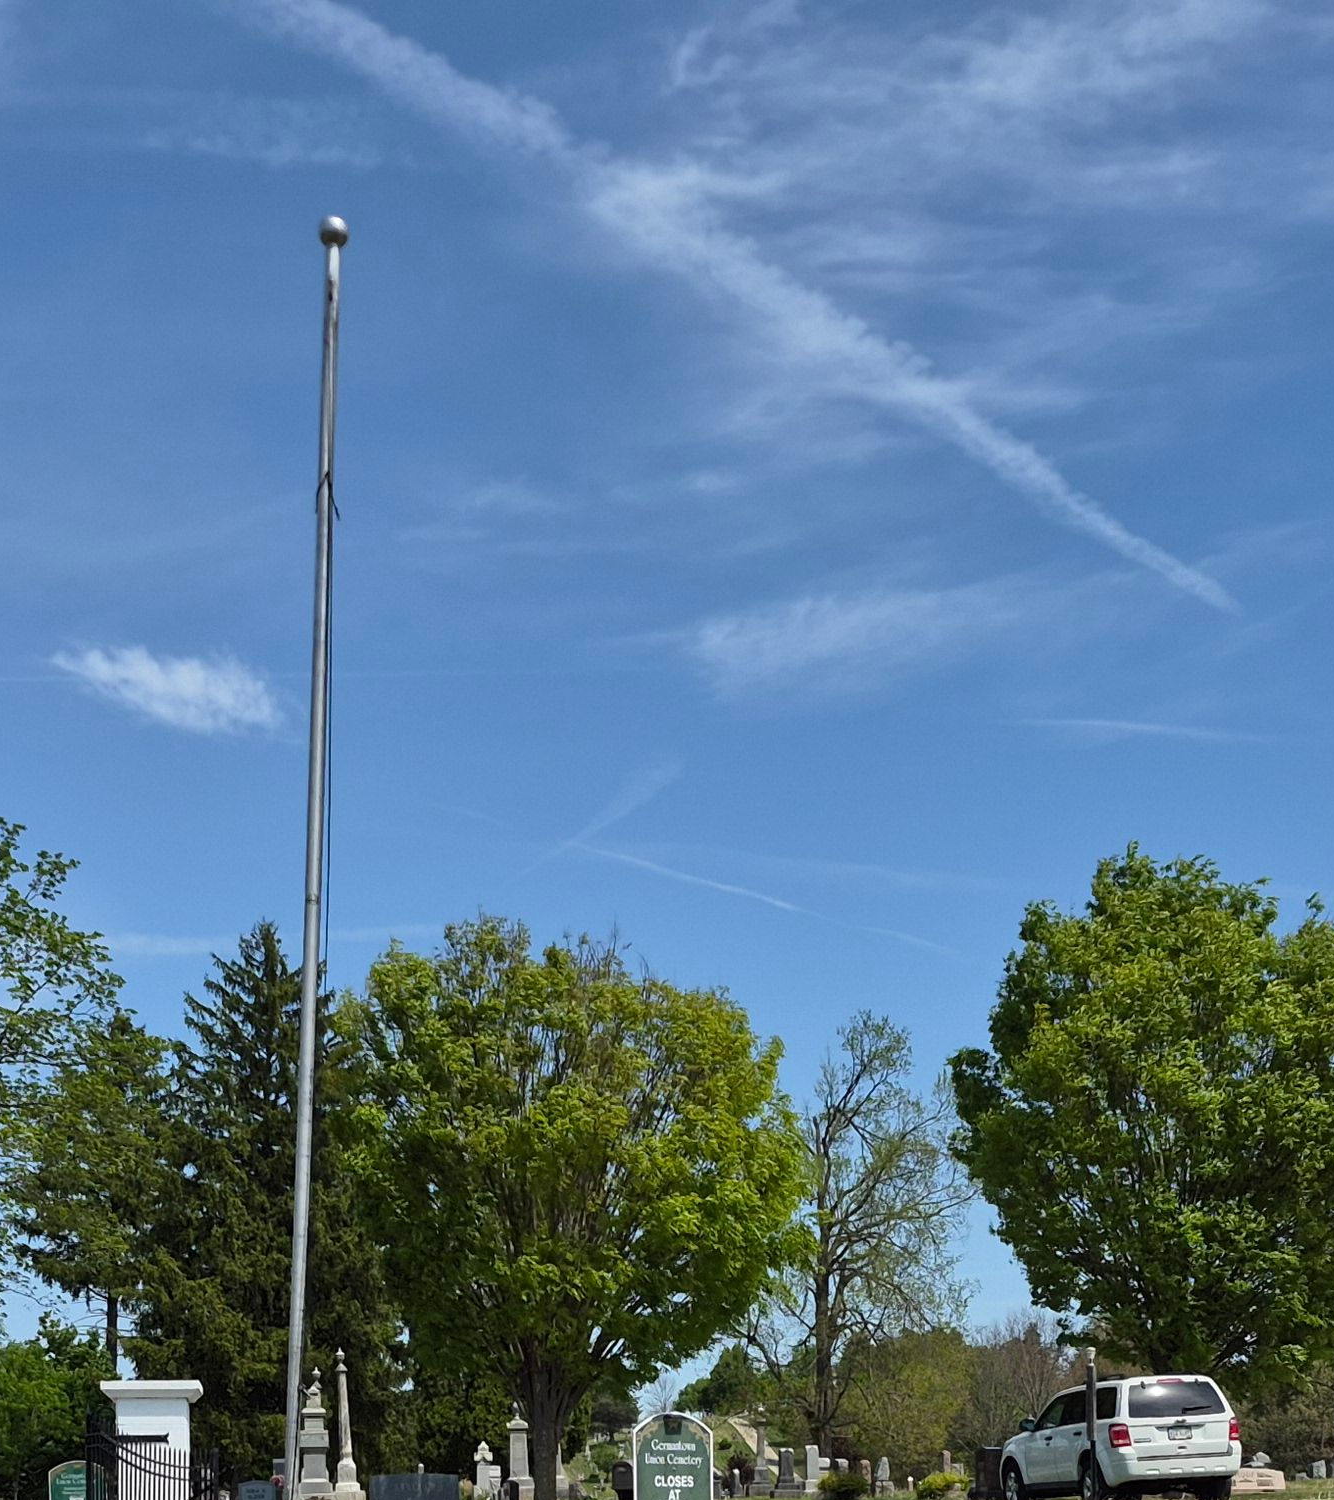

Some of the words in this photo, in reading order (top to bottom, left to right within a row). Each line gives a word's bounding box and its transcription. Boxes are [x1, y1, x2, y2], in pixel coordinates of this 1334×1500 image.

[645, 1452, 666, 1465] Union
[667, 1453, 703, 1468] Cemetery
[654, 1475, 694, 1488] CLOSES
[668, 1489, 681, 1500] AT
